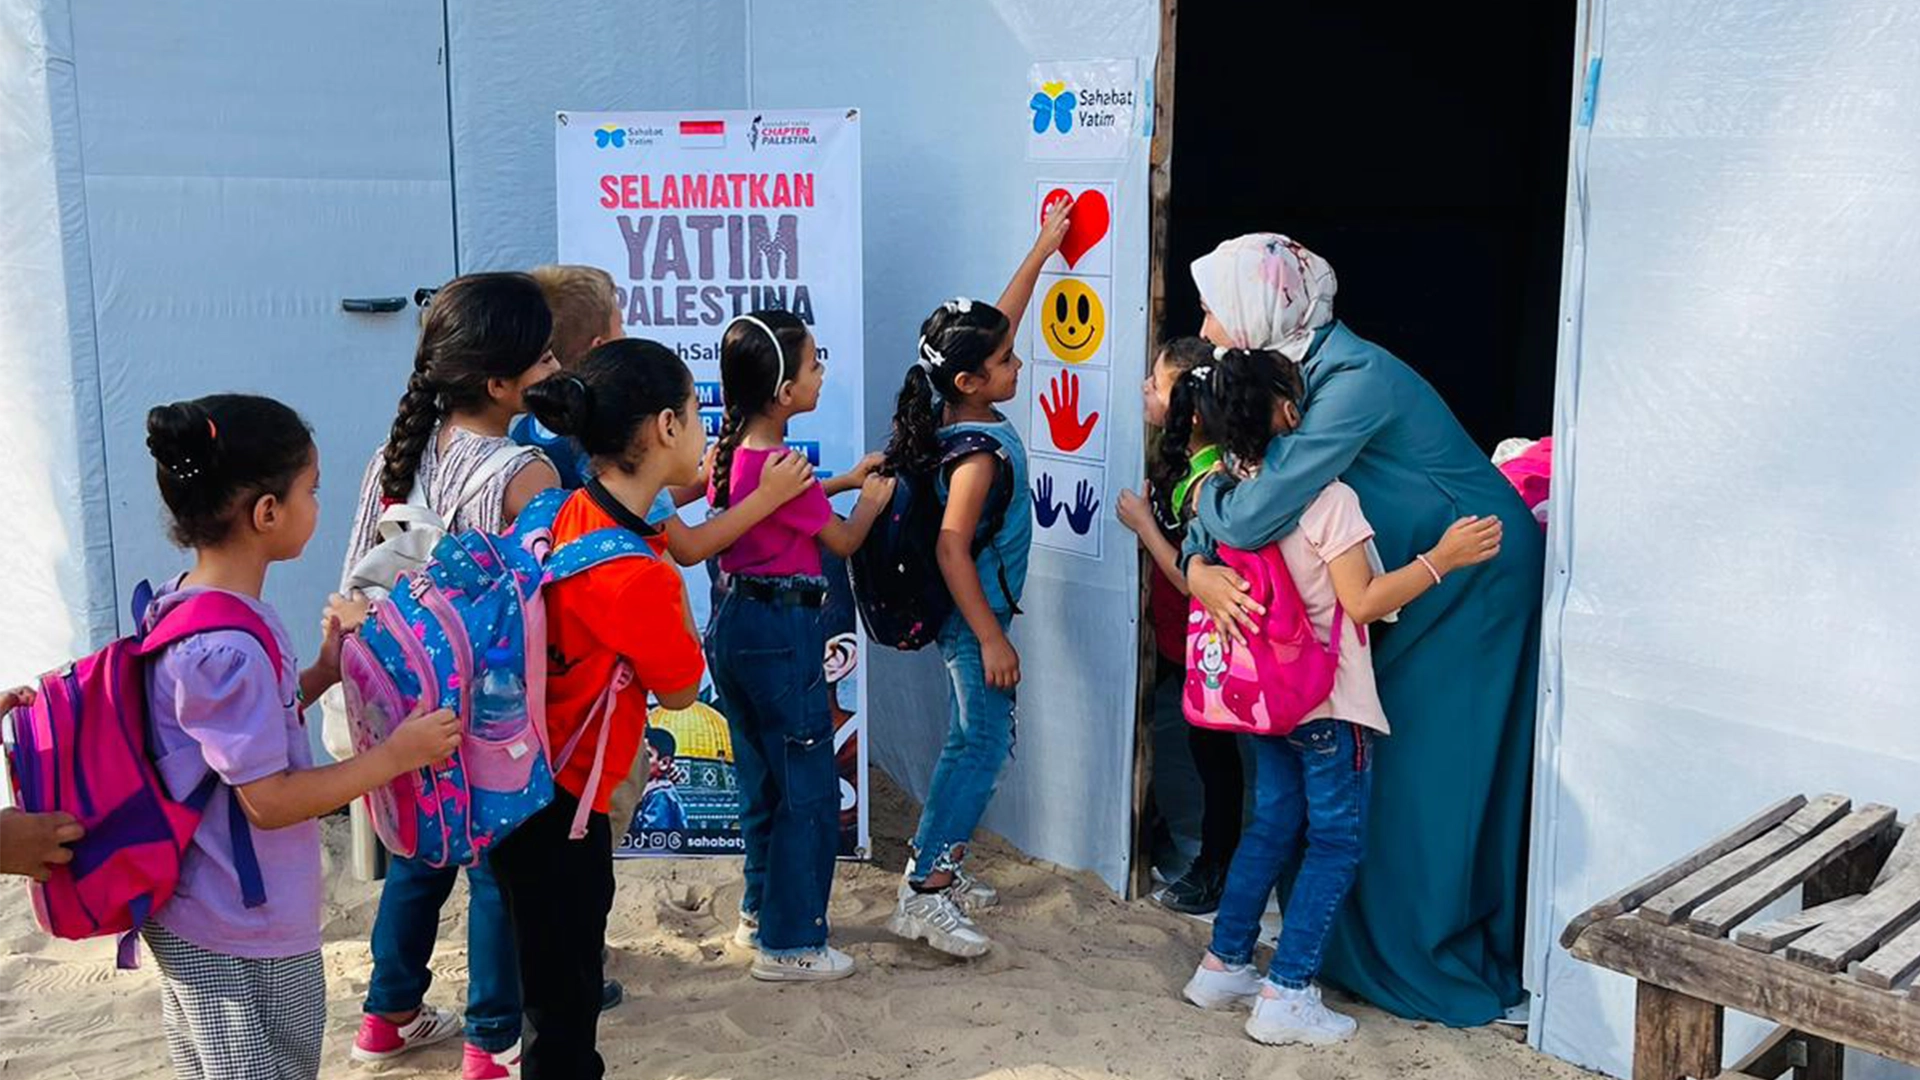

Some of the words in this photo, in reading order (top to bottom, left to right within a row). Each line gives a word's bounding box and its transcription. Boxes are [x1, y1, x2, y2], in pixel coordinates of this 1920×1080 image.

[1080, 89, 1133, 106] Sahabat
[1079, 110, 1115, 127] Yatim
[761, 128, 810, 137] CHAPTER
[761, 135, 818, 145] PALESTINA
[600, 173, 815, 210] SELAMATKAN
[616, 215, 799, 280] YATIM
[687, 836, 746, 850] sahabaty
